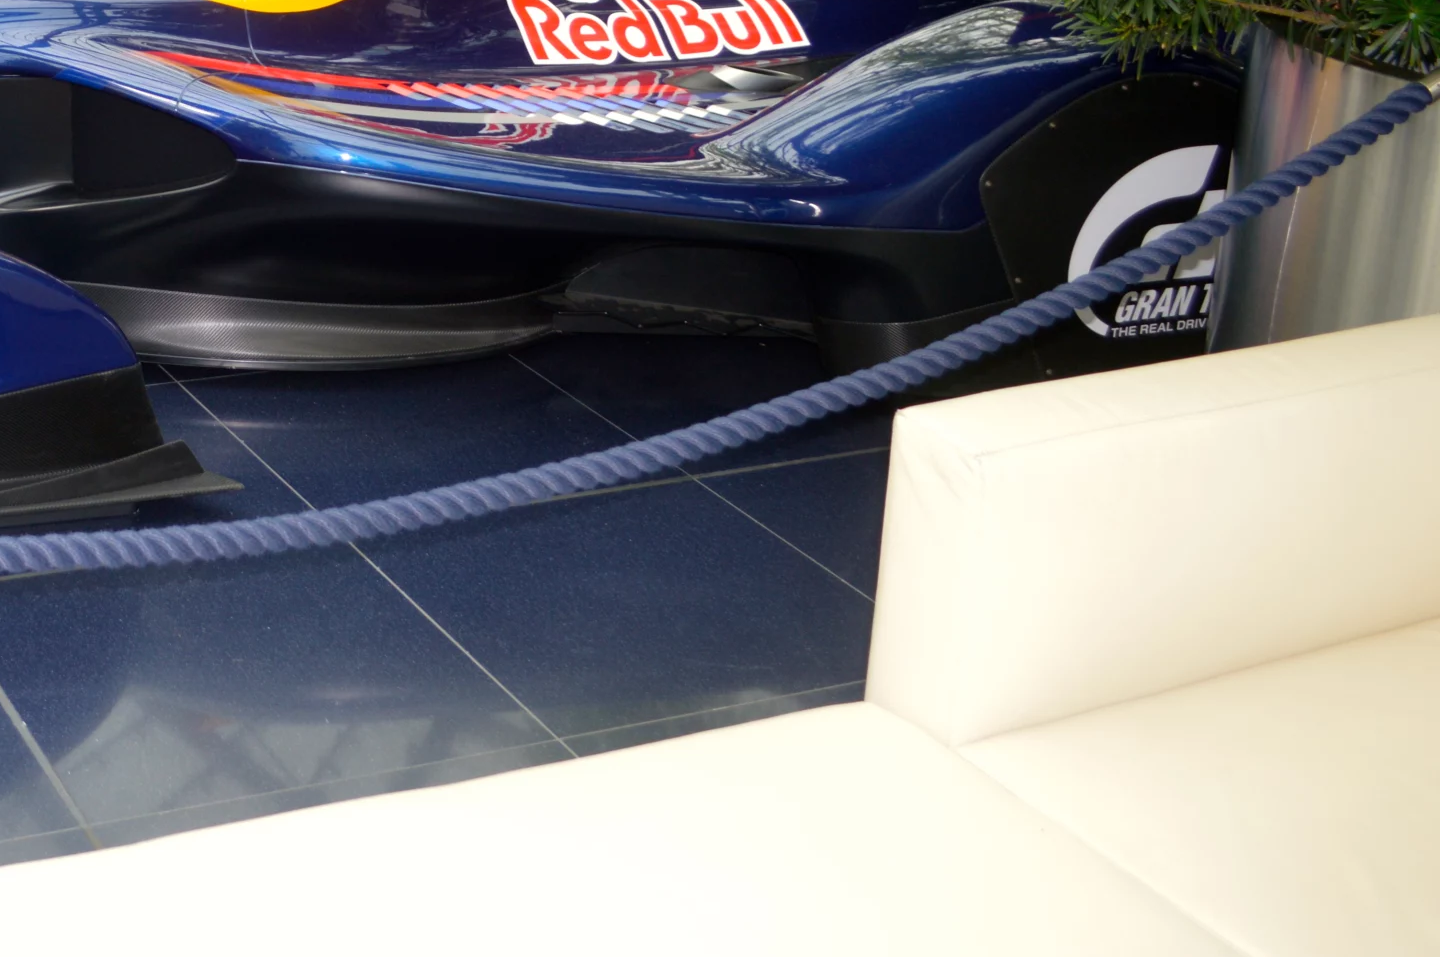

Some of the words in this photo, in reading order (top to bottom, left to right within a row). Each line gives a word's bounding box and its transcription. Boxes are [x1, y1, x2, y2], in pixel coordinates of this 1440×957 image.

[1114, 285, 1194, 324] GRAN
[1111, 326, 1137, 338] THE
[1139, 322, 1174, 335] REAL
